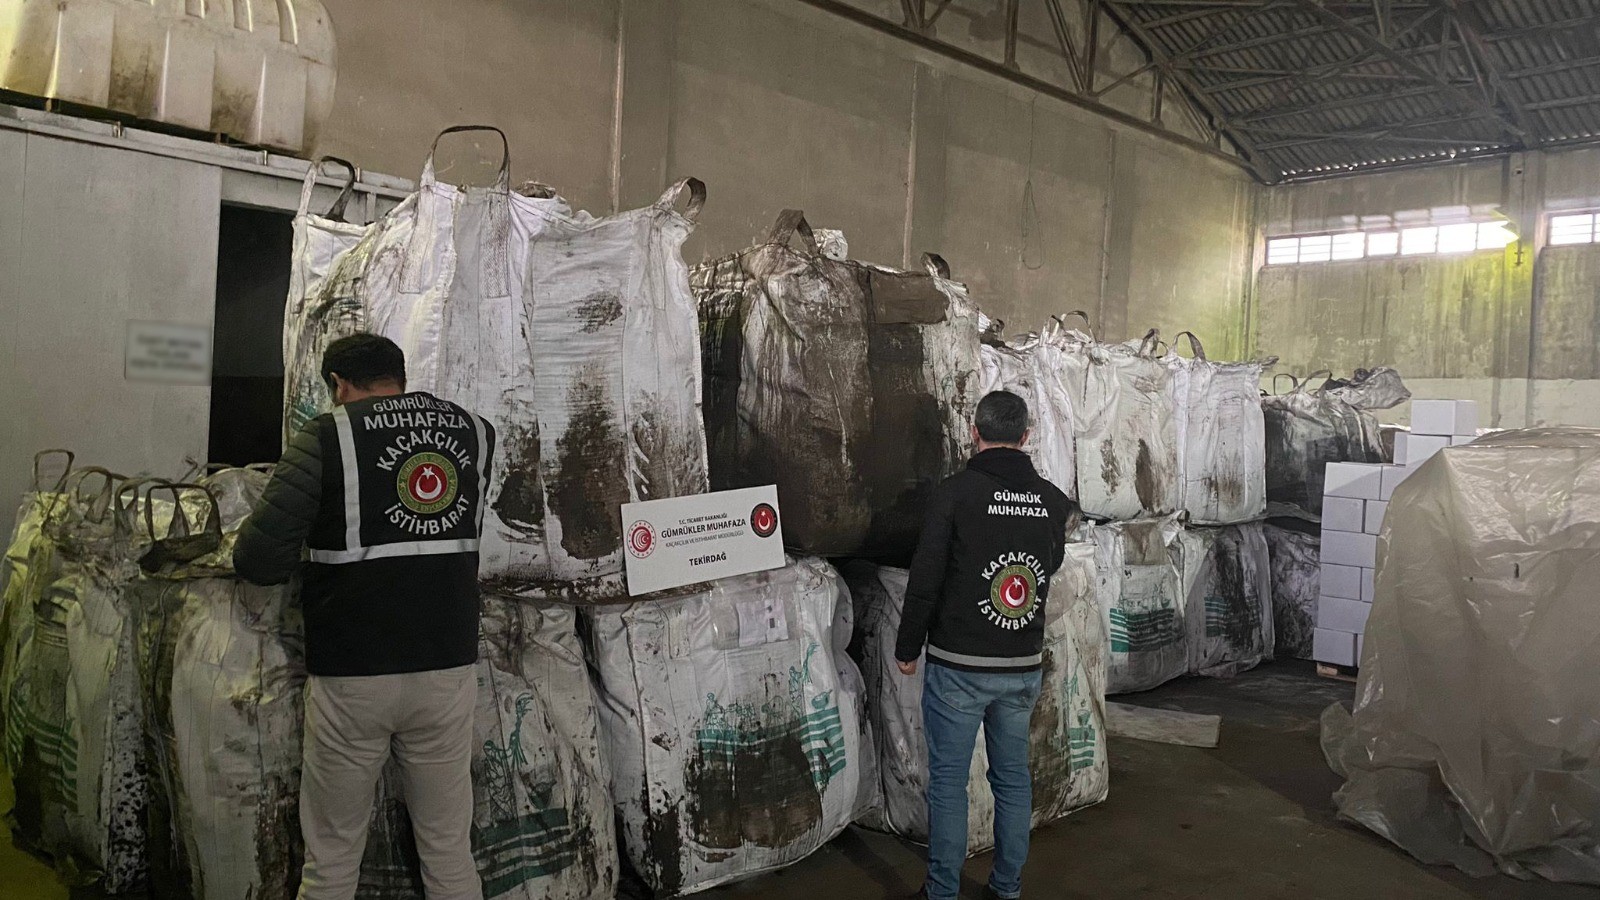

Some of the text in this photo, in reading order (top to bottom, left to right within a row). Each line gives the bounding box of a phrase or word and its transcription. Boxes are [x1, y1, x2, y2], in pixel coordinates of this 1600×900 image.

[373, 395, 453, 412] GÜMRÜKLER
[363, 411, 469, 430] MUHAFAZA
[376, 429, 471, 471] KAÇAKÇILIK
[993, 490, 1042, 504] GÜMRÜK
[384, 494, 470, 535] İSTİHBARAT
[987, 504, 1049, 518] MUHAFAZA
[661, 519, 746, 538] GÜMRÜKLER MUHAFAZA
[689, 552, 727, 566] TEKİRDAĞ
[981, 551, 1046, 587] KAÇAKÇILIK
[977, 595, 1043, 630] İSTİHBARAT
